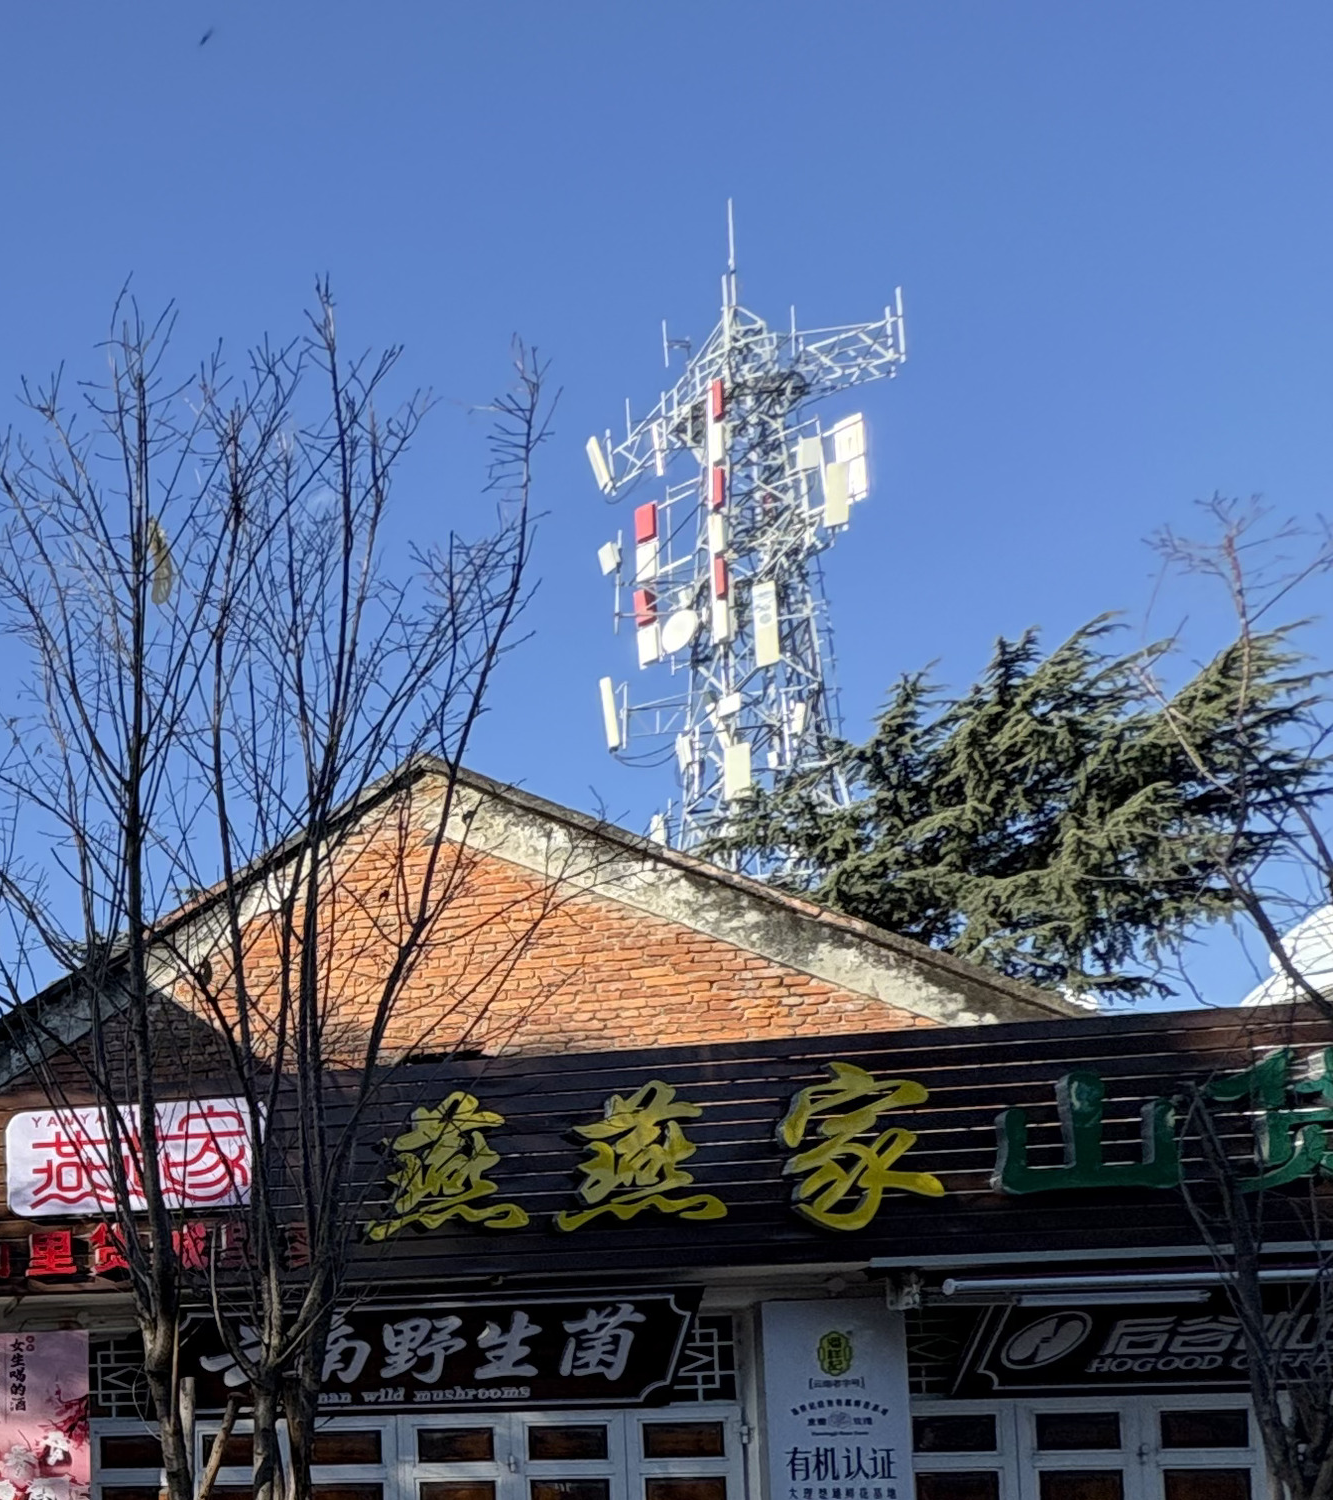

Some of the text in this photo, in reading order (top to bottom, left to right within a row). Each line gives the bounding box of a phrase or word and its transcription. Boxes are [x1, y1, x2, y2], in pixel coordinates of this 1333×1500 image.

[9, 1338, 28, 1413] 女生喝的酒
[1085, 1354, 1224, 1373] HOGOOD
[361, 1386, 405, 1403] wild
[413, 1384, 532, 1402] mushrooms
[785, 1446, 898, 1482] 有机认证
